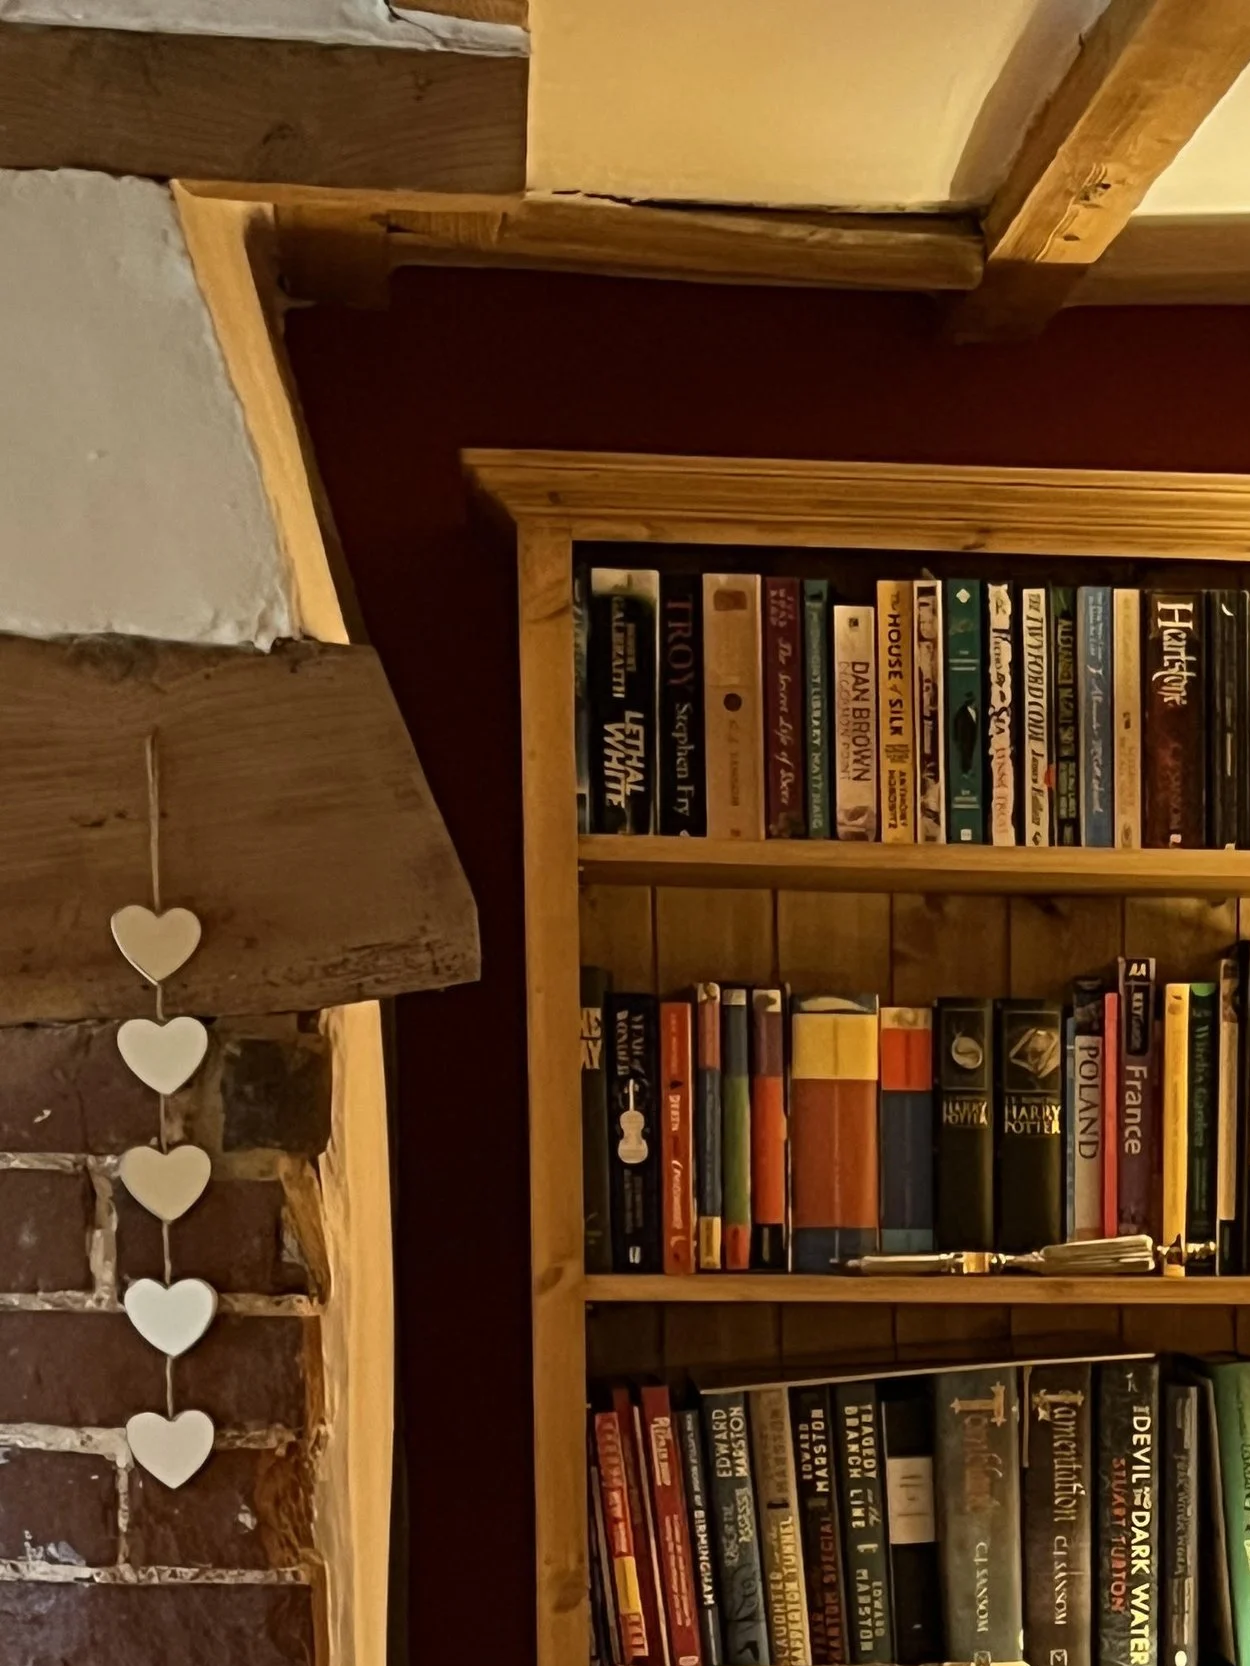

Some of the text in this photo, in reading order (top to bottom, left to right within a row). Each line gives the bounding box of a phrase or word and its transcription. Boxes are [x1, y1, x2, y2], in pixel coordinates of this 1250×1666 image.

[611, 596, 626, 699] GALBRAITH
[666, 594, 695, 692] TROY
[887, 613, 904, 737] HOUSE SILK
[1027, 615, 1045, 699] TWYFORD
[1151, 600, 1195, 707] Heartstone
[624, 710, 645, 796] LETHAL
[671, 703, 695, 817] Stephen Fry
[773, 715, 791, 748] Life
[811, 686, 823, 831] LIBRARY MATT HAIG
[851, 660, 871, 783] DAN BROWN
[1027, 700, 1044, 744] CODE
[603, 722, 626, 808] WHITE
[1004, 1104, 1062, 1120] HARRY
[1077, 1045, 1101, 1160] POLAND
[1124, 1064, 1148, 1156] France
[711, 1409, 733, 1479] EDWARD
[728, 1406, 750, 1479] MARSTON
[798, 1422, 812, 1480] EDWARD
[810, 1408, 830, 1494] MARSTON
[843, 1405, 866, 1530] BRANCH LINE
[860, 1403, 878, 1479] TRAGEDY
[1031, 1389, 1086, 1522] Lamentation
[693, 1509, 715, 1606] BIRMINGHAM
[779, 1515, 799, 1575] TUNNEL
[1109, 1457, 1127, 1612] STUART TURTON
[1130, 1416, 1153, 1666] DEVIL DARK WATER
[855, 1568, 875, 1652] MARSTON
[872, 1580, 885, 1637] EDWARD
[975, 1568, 989, 1633] SANSOM
[1053, 1561, 1069, 1625] SANSOM
